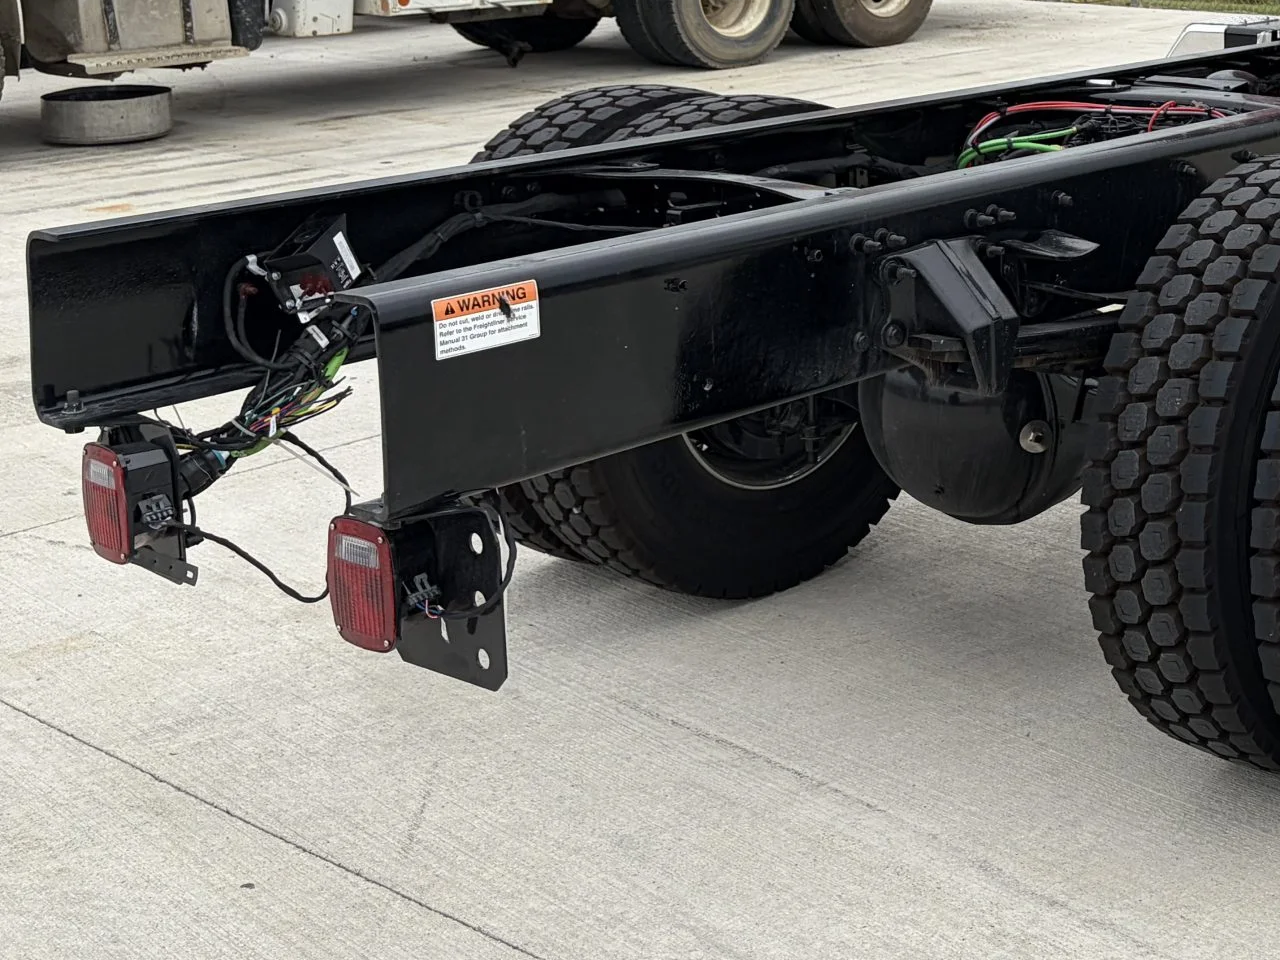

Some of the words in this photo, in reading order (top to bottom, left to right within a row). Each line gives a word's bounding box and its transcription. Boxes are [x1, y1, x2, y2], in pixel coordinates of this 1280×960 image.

[470, 314, 485, 322] weld
[439, 329, 455, 338] Refer
[456, 327, 463, 335] to
[462, 324, 473, 332] the
[473, 318, 505, 332] Freightliner
[439, 336, 461, 347] Manual
[470, 331, 488, 340] Group
[488, 328, 497, 336] for
[497, 321, 528, 334] attachment
[439, 344, 466, 355] methods.
